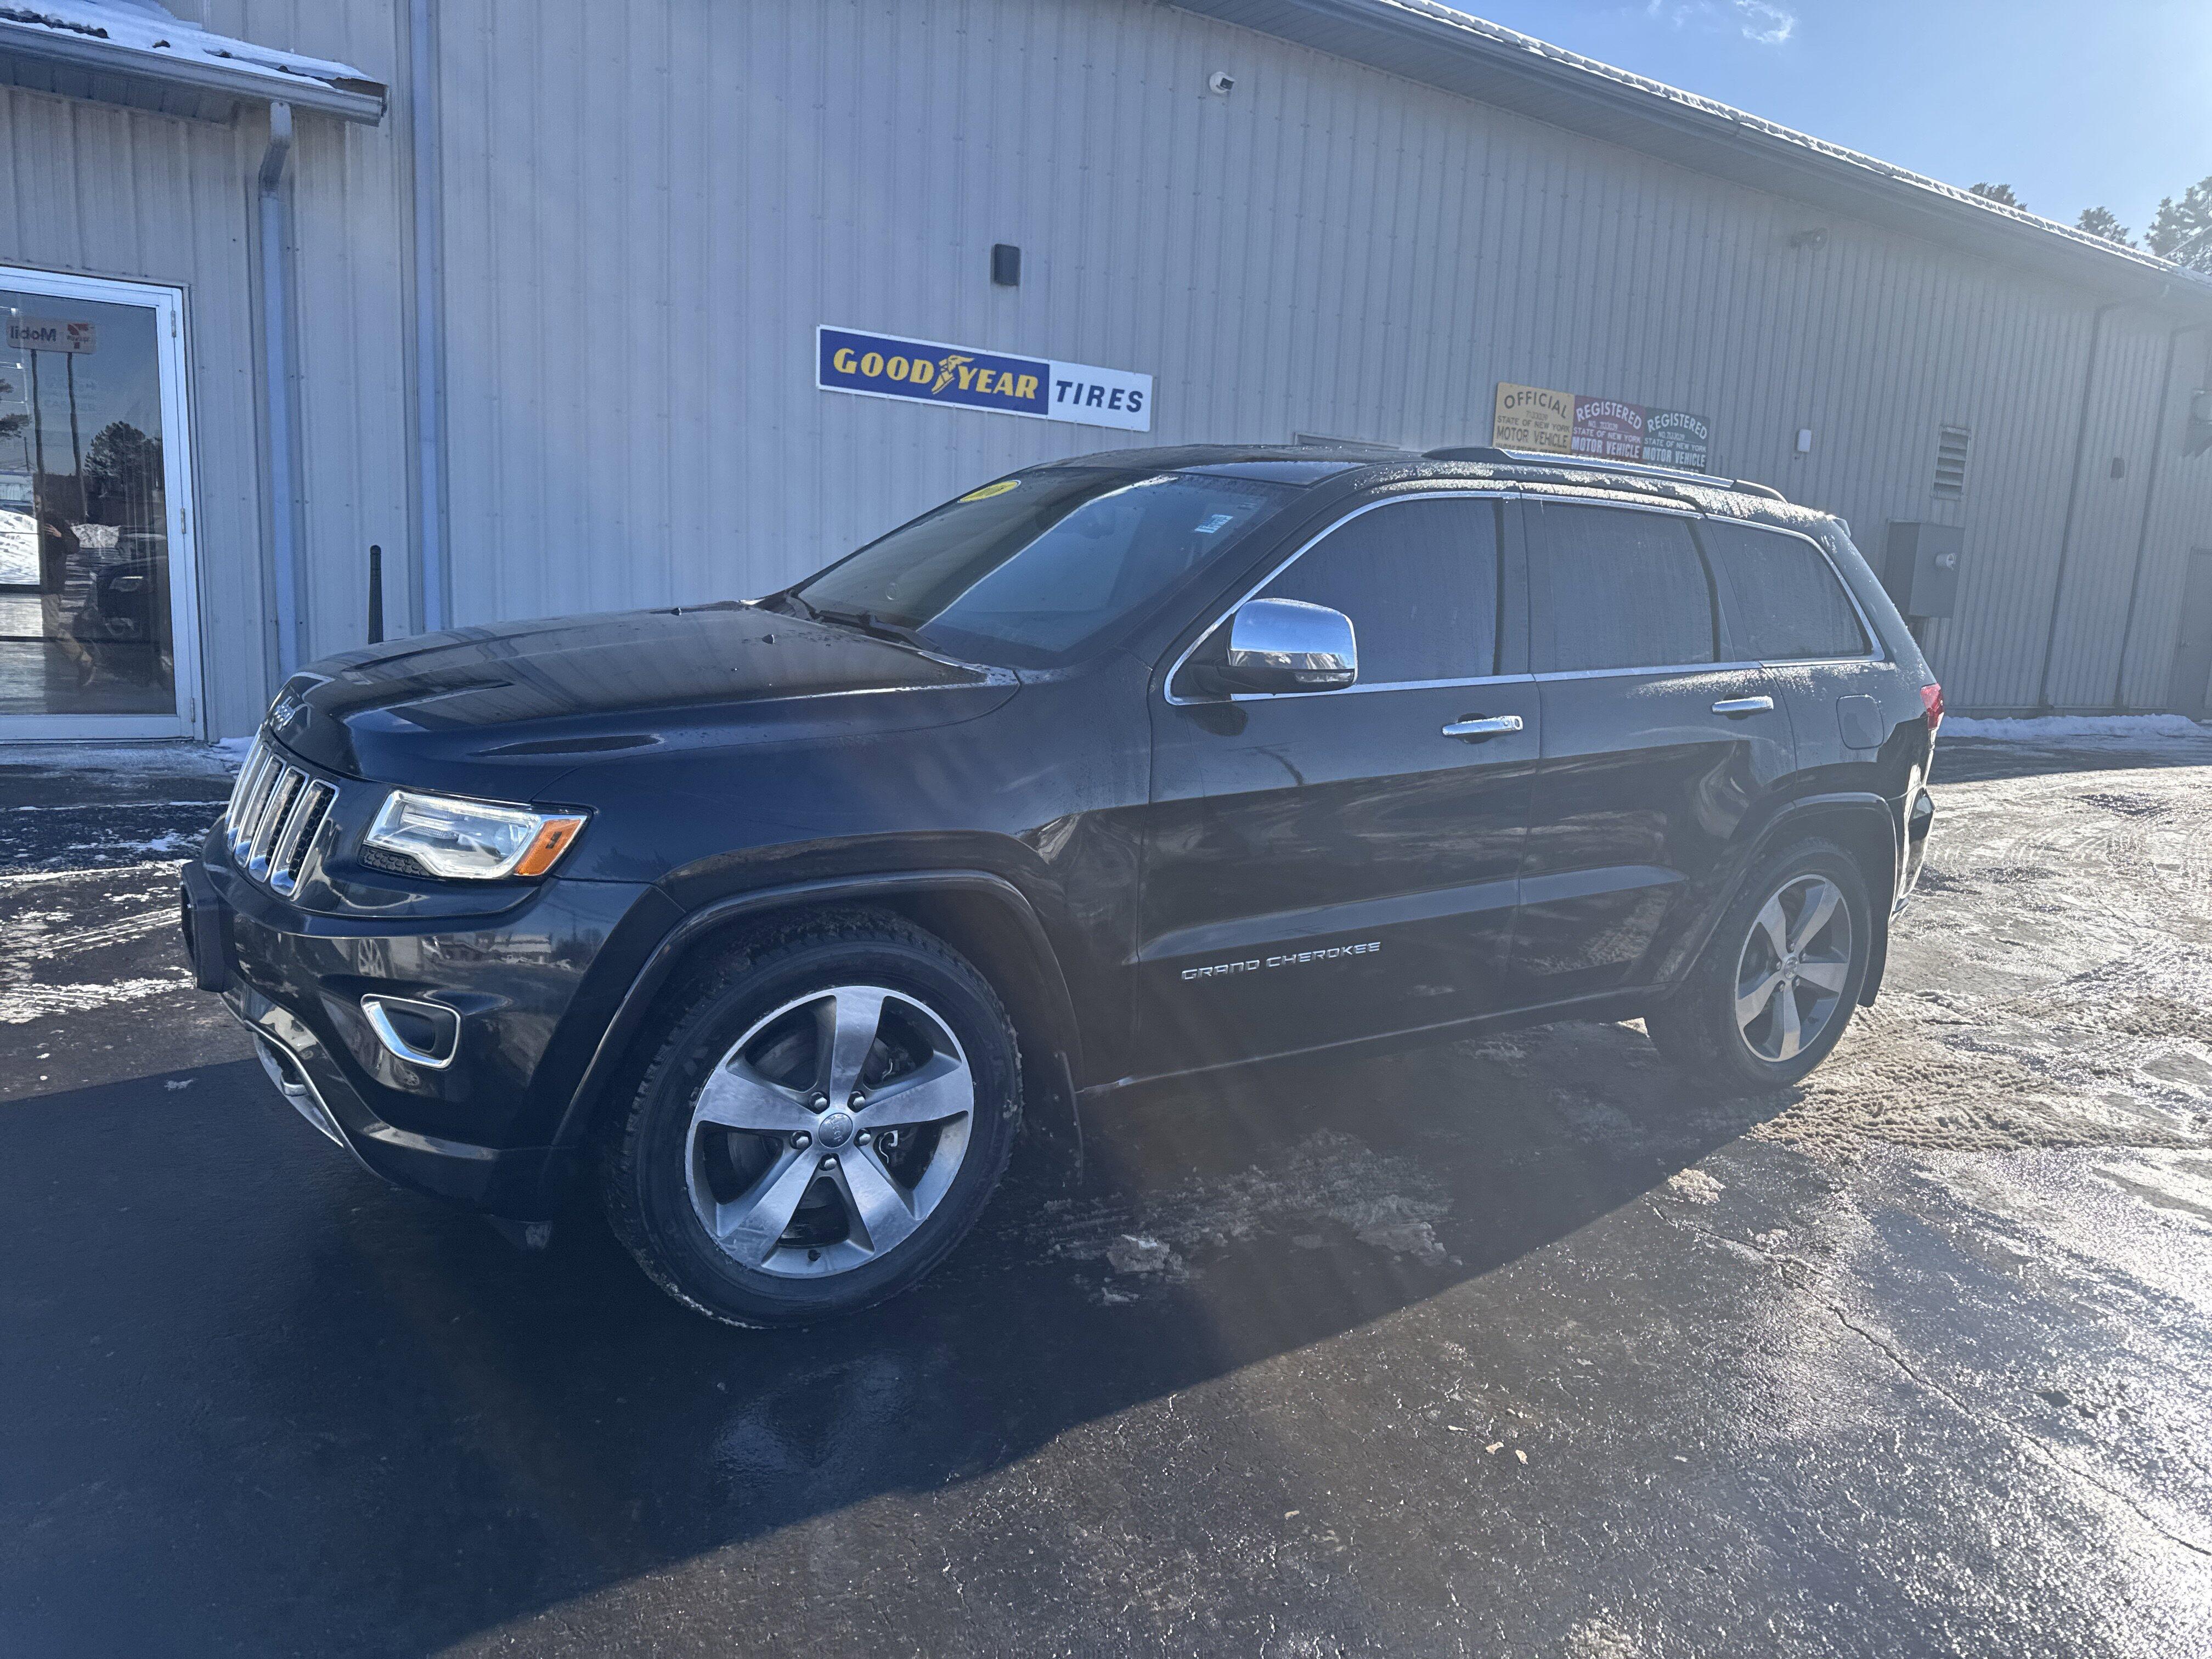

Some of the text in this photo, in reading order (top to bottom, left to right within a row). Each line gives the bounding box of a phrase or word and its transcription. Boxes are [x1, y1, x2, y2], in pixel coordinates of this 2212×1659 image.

[1056, 380, 1143, 413] TIRES
[1504, 391, 1567, 419] OFFICIAL
[1497, 415, 1519, 425] STATE
[1535, 421, 1549, 429] NEW
[1551, 424, 1570, 432] YORK
[1576, 400, 1642, 430] REGISTERED
[1647, 413, 1707, 439] REGISTERED
[1496, 425, 1529, 443] MOTOR
[1533, 430, 1568, 449] VEHICLE
[1571, 436, 1602, 454] MOTOR
[1606, 441, 1640, 459] VEHICLE
[1573, 427, 1594, 436] STATE
[1607, 432, 1622, 441] NEW
[1624, 435, 1641, 444] YORK
[1644, 437, 1664, 447] STATE
[1676, 442, 1689, 450] NEW
[1691, 444, 1707, 453] YORK
[1642, 447, 1672, 463] MOTOR
[1675, 450, 1706, 467] VEHICLE
[1181, 941, 1381, 980] GRAND CHEROKEE
